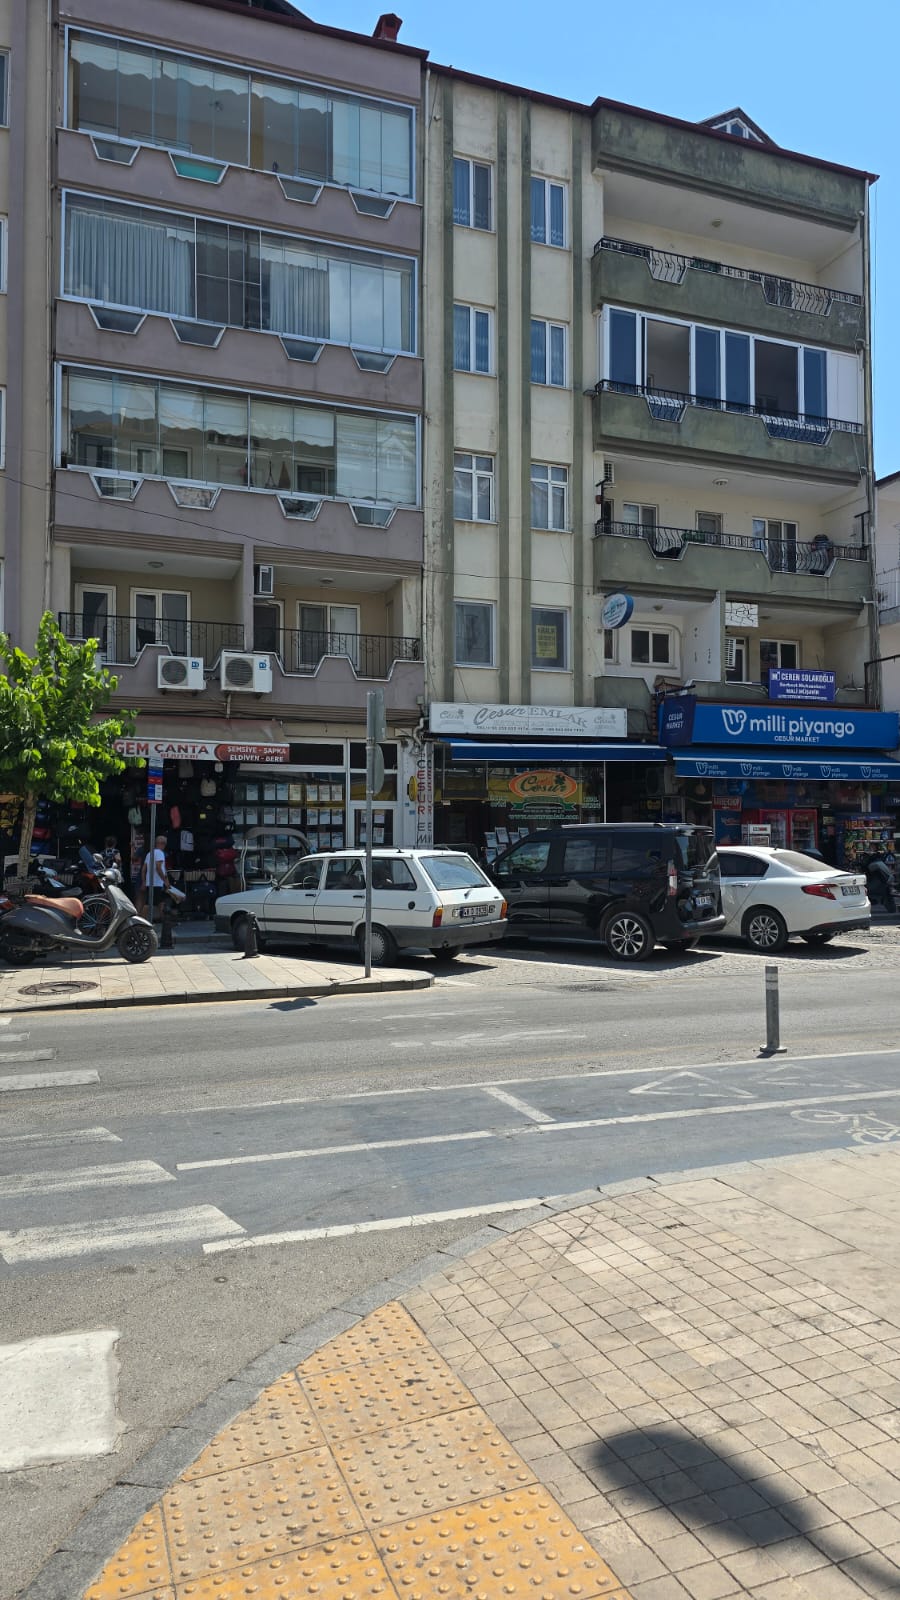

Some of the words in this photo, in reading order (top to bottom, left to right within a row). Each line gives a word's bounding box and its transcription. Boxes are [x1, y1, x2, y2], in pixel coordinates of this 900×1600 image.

[781, 672, 801, 681] CEREN
[473, 707, 527, 726] Cesur
[529, 707, 588, 728] EMLAK
[750, 715, 786, 733] milli
[788, 719, 855, 738] piyango
[154, 743, 209, 755] ÇANTA
